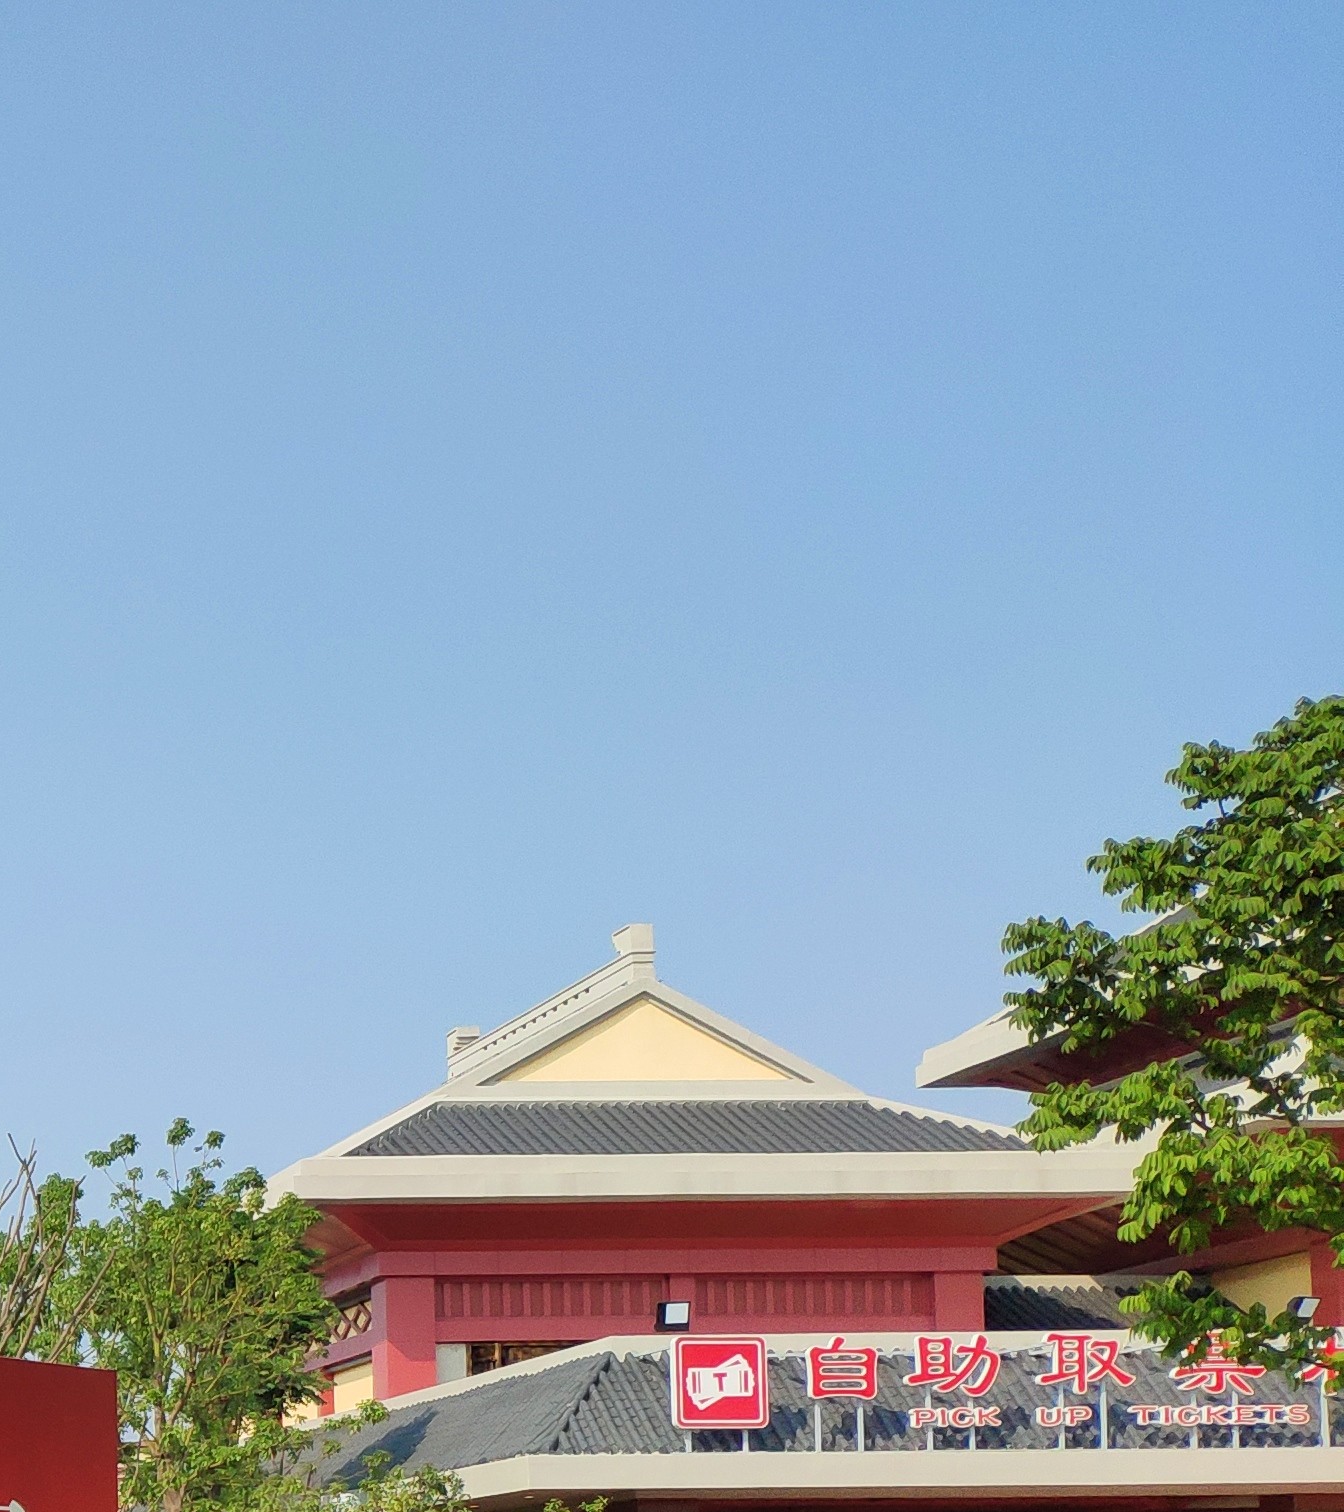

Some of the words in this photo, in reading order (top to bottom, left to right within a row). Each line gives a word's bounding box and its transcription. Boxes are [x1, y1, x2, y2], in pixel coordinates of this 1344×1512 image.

[908, 1405, 1003, 1428] PICK
[1035, 1405, 1093, 1427] UP
[1125, 1404, 1311, 1426] TICKETS
